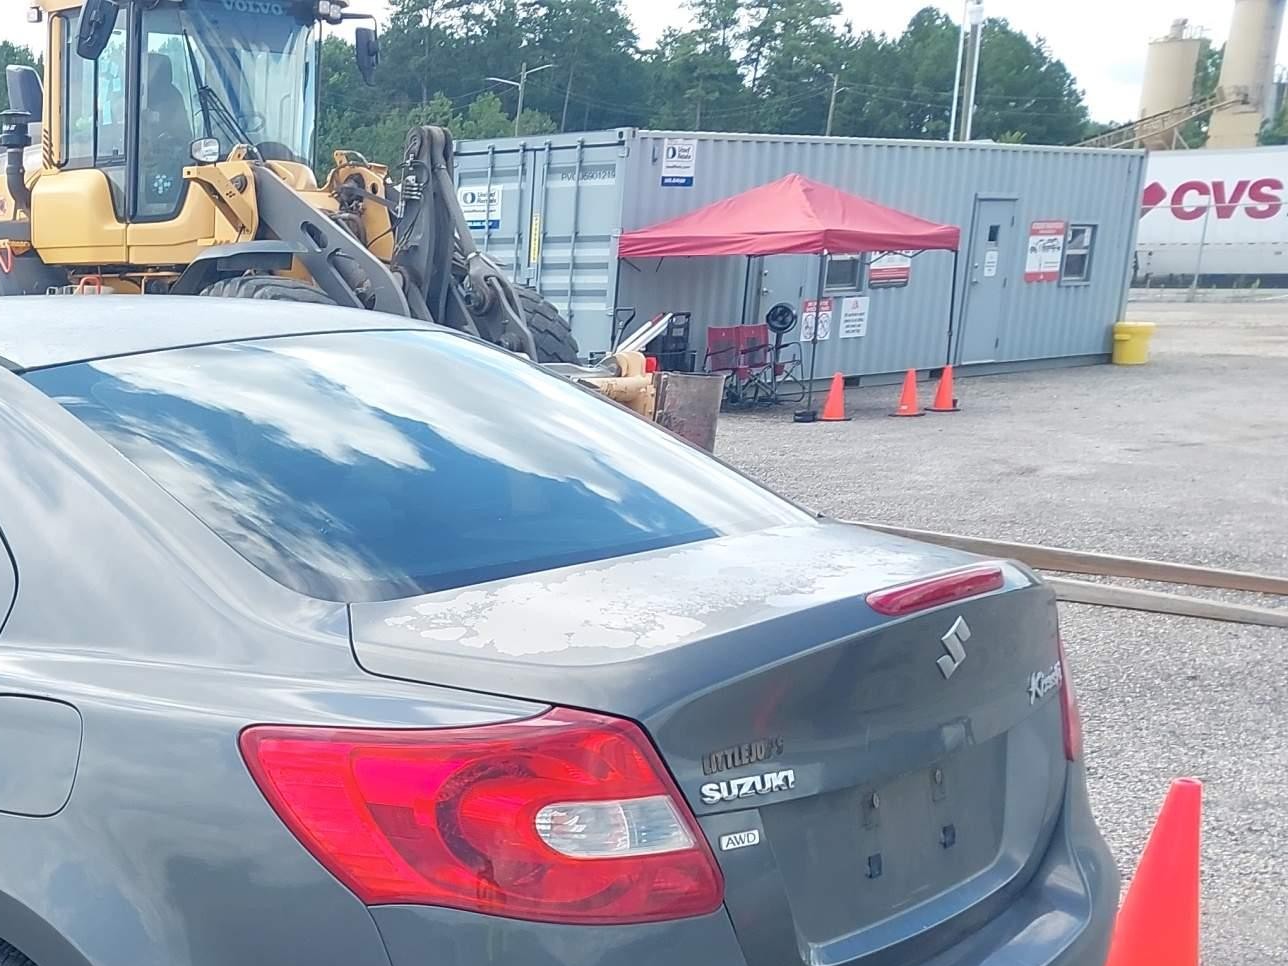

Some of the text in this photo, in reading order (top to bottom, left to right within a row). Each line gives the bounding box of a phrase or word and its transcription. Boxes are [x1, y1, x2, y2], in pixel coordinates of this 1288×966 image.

[223, 0, 284, 16] VOLVO
[1170, 178, 1284, 220] CVS
[701, 769, 795, 805] SUZUKI
[725, 832, 756, 849] AWD
